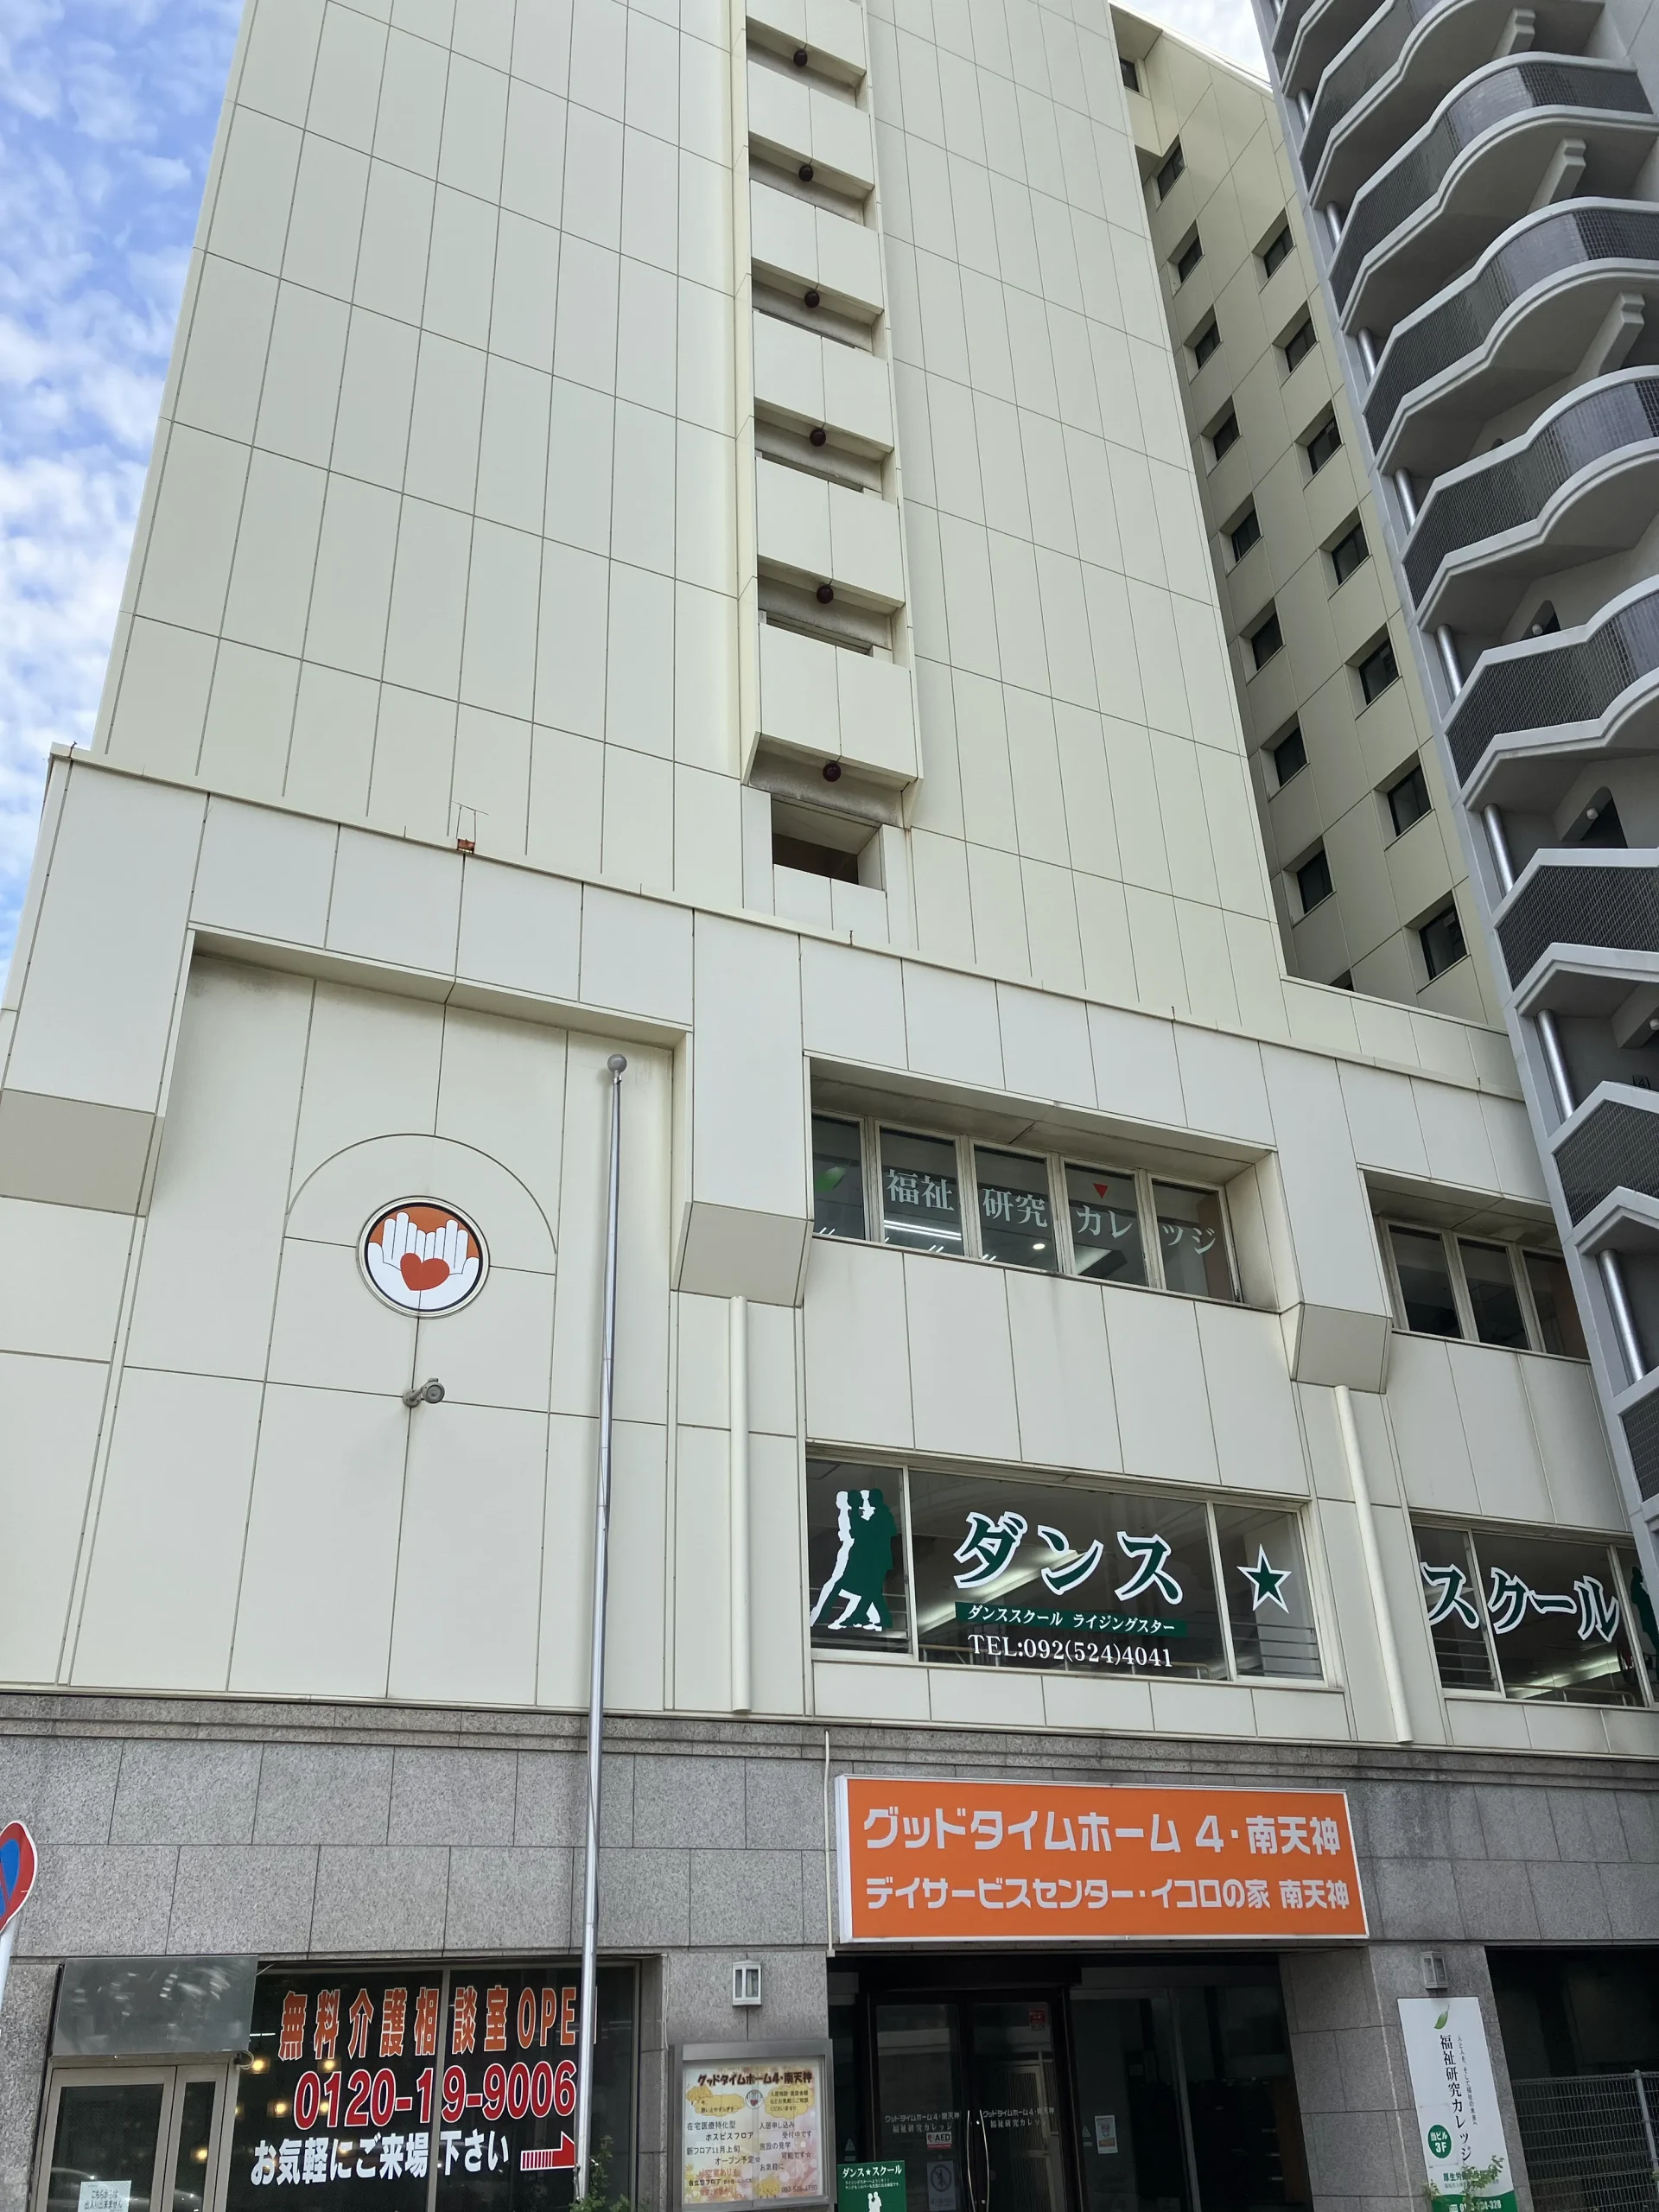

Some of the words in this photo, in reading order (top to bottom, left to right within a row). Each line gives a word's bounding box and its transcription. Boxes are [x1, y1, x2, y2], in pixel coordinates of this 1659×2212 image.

[952, 1511, 1184, 1605] ダンス
[1420, 1561, 1619, 1642] スクール
[967, 1605, 1063, 1628] ダンススクール
[1073, 1612, 1176, 1633] ライジングスター
[967, 1634, 1173, 1669] TEL:092(524)4041
[1279, 1879, 1349, 1910] 南天神
[293, 2060, 577, 2131] 0120-19-9006
[1440, 2034, 1472, 2161] 福祉研究カレッジ
[687, 2120, 736, 2131] 在宅医療特化型
[760, 2121, 795, 2130] 入居申し込み
[705, 2132, 754, 2142] ホスピスフロア
[782, 2131, 812, 2139] 受付中です
[1430, 2131, 1448, 2141] 当ビル
[686, 2145, 741, 2156] 新フロア11月上旬
[760, 2141, 791, 2151] 施設の見学
[1434, 2141, 1447, 2154] 3F
[760, 2163, 785, 2171] お気軽に
